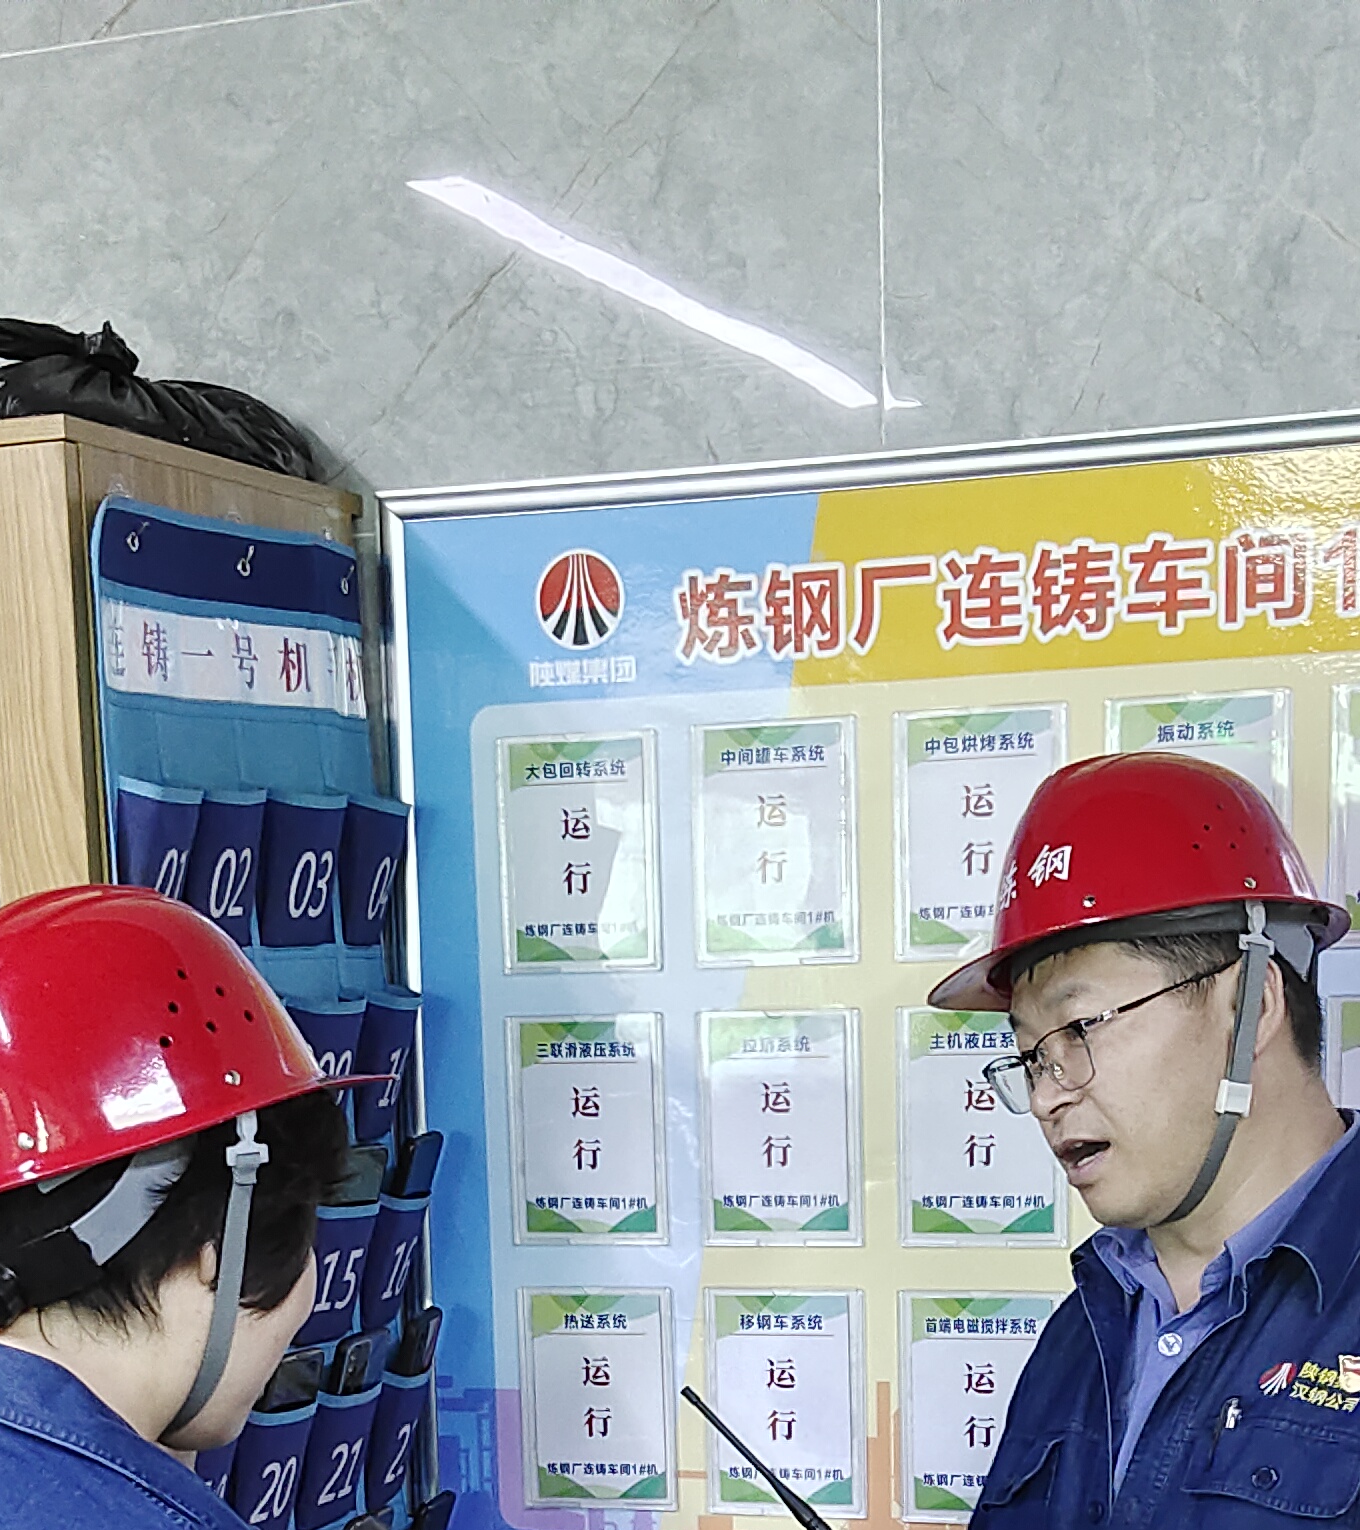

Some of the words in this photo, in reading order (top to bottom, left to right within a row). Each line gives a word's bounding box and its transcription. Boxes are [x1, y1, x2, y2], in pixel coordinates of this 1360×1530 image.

[1156, 719, 1237, 744] 振动系统
[924, 732, 1036, 756] 中包烘烤系统
[720, 745, 827, 767] 中间罐车系统
[524, 759, 628, 781] 大包回转系统
[209, 847, 252, 919] 02
[288, 850, 334, 919] 03
[535, 1196, 649, 1211] 炼钢厂连铸车间1#机
[722, 1193, 840, 1209] 炼钢厂连铸车间1#机
[921, 1194, 1046, 1209] 炼钢厂连铸车间1#机
[313, 1247, 365, 1313] 15
[563, 1312, 628, 1331] 热送系统
[739, 1313, 824, 1332] 移钢车系统
[924, 1317, 1038, 1336] 首端电磁搅拌系统
[1298, 1361, 1342, 1389] 陕钢
[317, 1437, 365, 1506] 21
[547, 1462, 659, 1476] 炼钢厂连铸车间1#机
[728, 1466, 845, 1482] 炼钢铸车间1#机
[249, 1455, 298, 1525] 20
